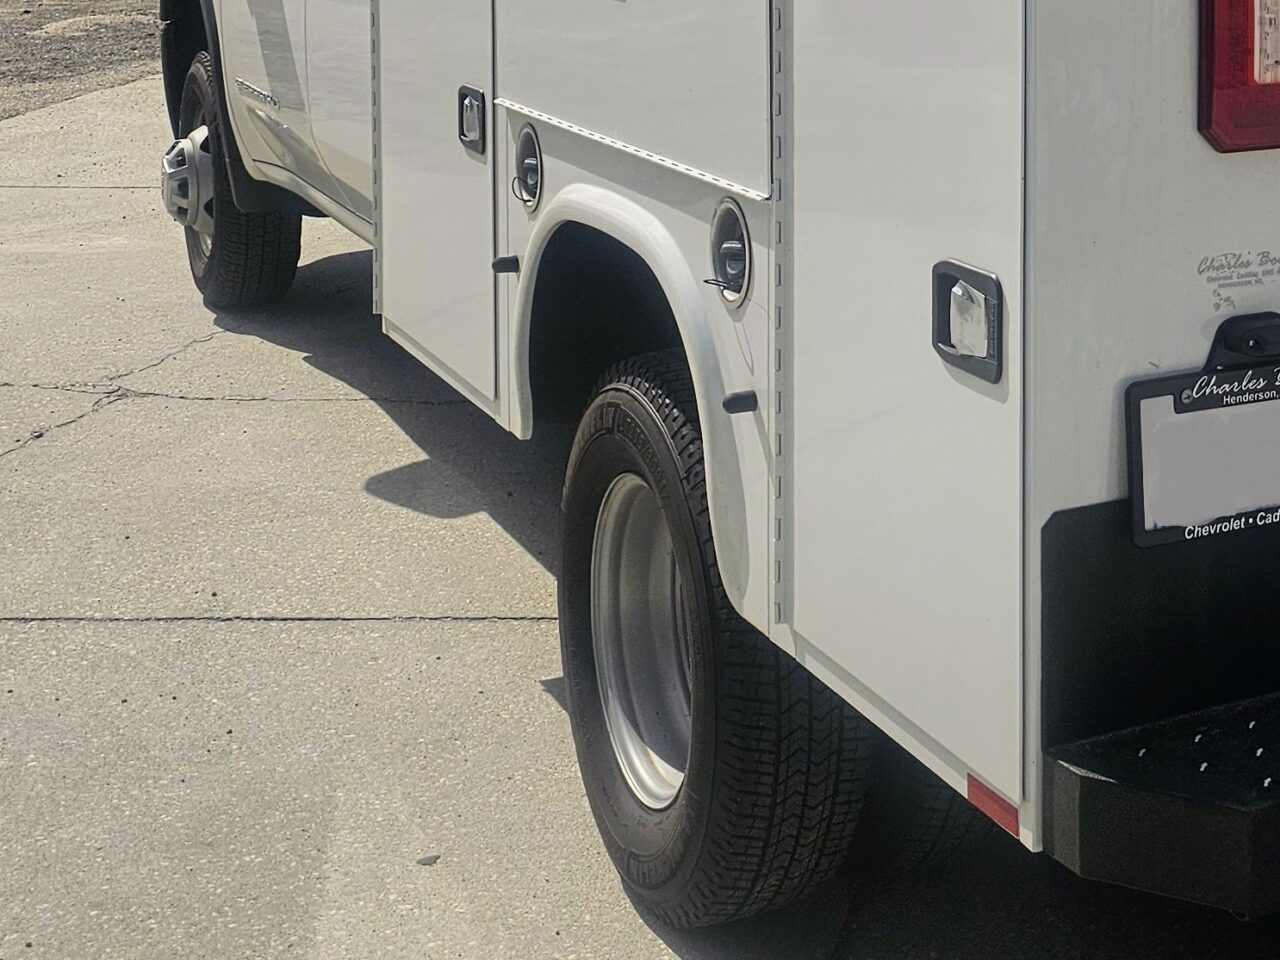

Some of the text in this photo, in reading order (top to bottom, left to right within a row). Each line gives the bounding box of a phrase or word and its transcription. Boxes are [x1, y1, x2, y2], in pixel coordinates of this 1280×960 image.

[1198, 252, 1253, 275] Charles
[1192, 370, 1267, 398] Charles
[1223, 391, 1279, 405] Henderson,
[1184, 518, 1246, 540] Chevrolet
